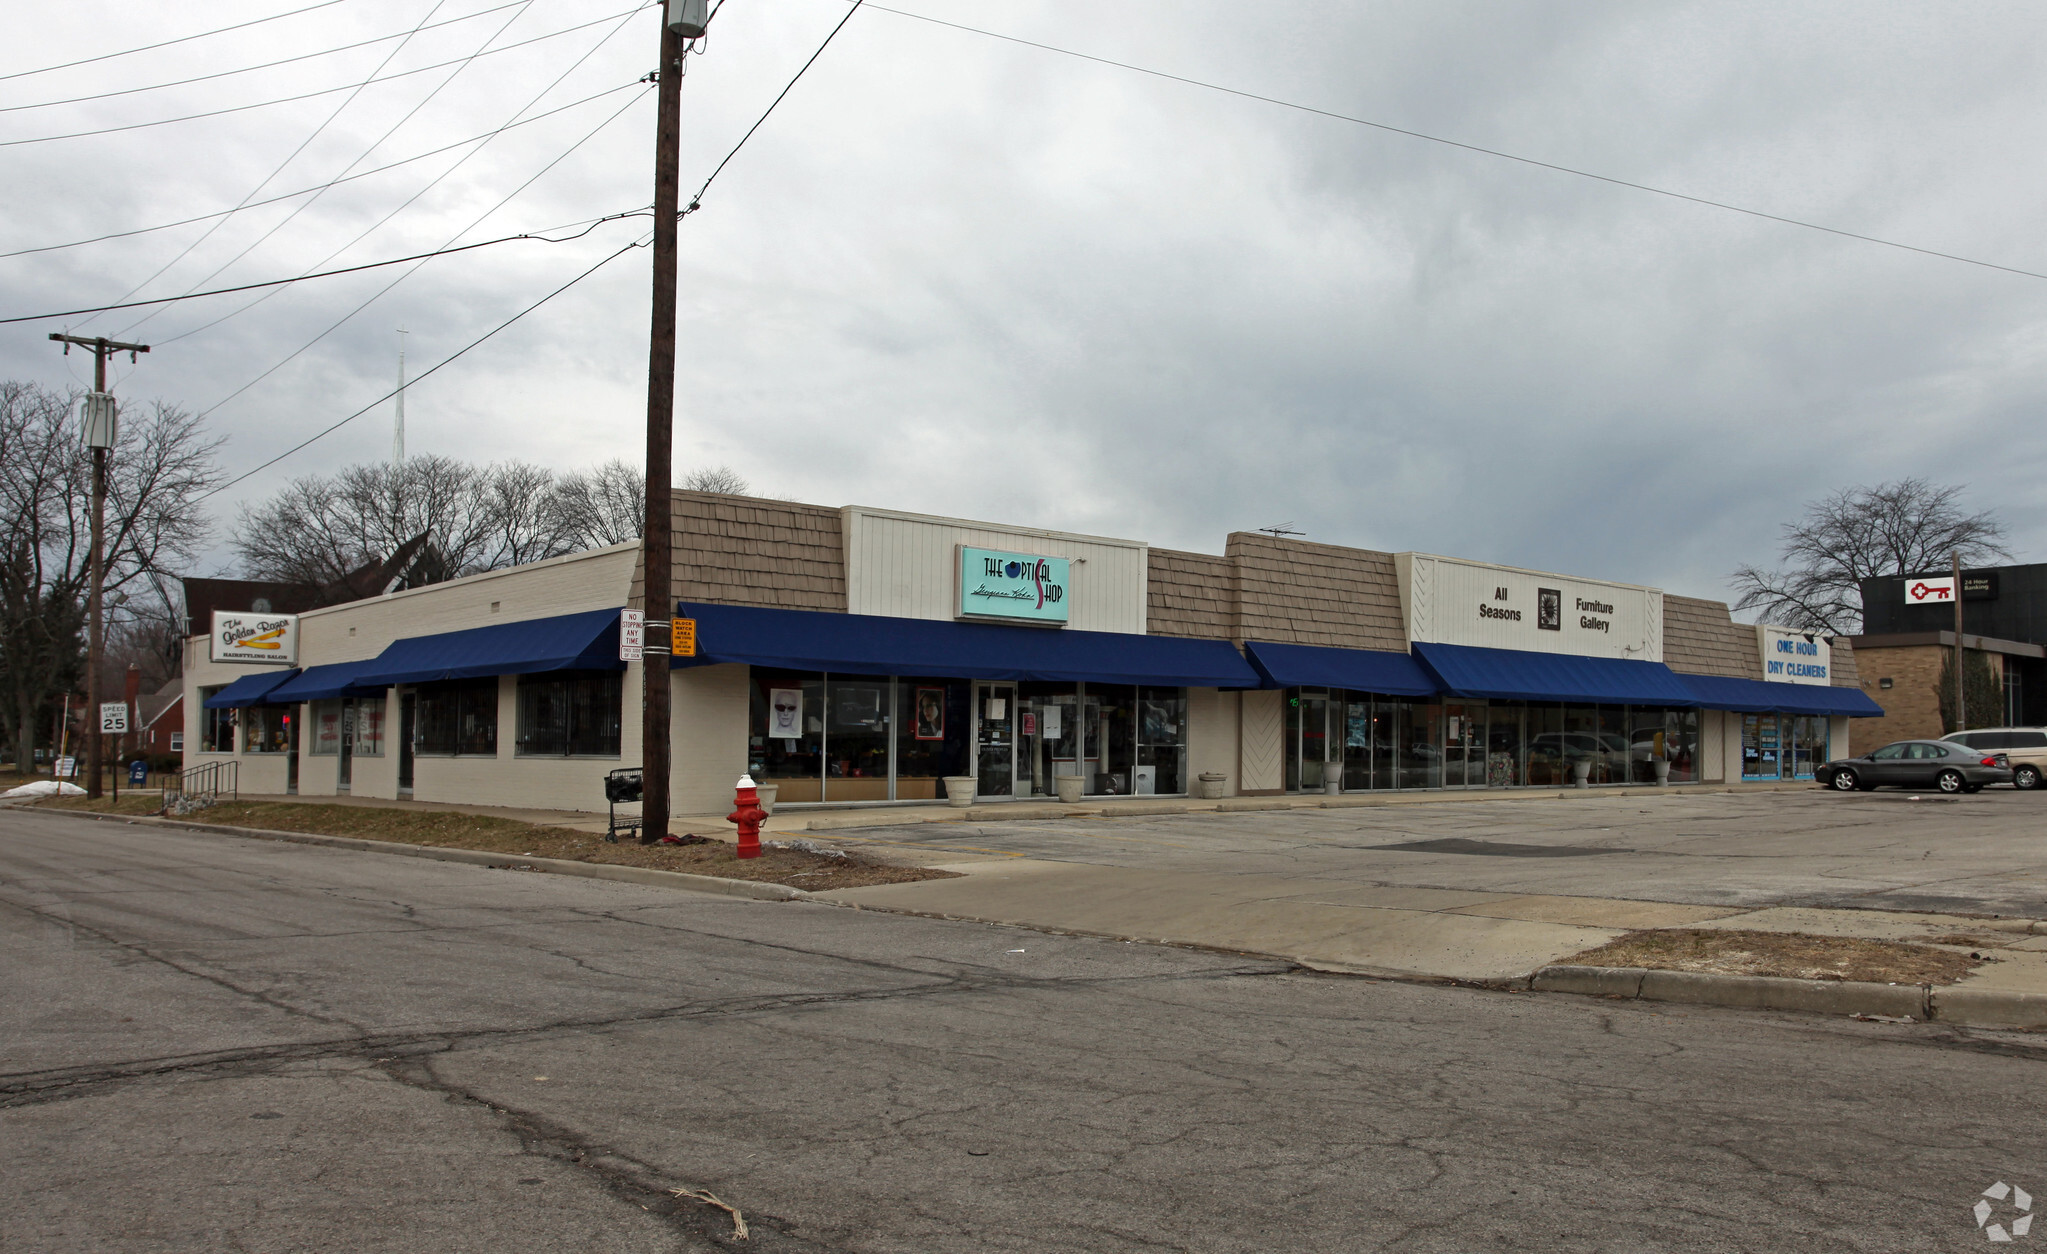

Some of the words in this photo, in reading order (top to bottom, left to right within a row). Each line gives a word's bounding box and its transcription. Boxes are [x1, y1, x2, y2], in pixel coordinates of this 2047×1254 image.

[984, 558, 1003, 577] THE
[1494, 587, 1508, 601] All
[1479, 603, 1522, 621] Seasons
[1576, 598, 1613, 614] Furniture
[222, 627, 256, 645] Golden
[256, 619, 290, 638] Razor
[223, 619, 242, 629] The
[622, 621, 643, 629] STOPPING
[1580, 616, 1610, 633] Gallery
[1777, 640, 1793, 653] ONE
[1796, 642, 1817, 656] HOUR
[1768, 661, 1784, 674] DRY
[1787, 663, 1826, 678] CLEANERS
[104, 719, 125, 729] 25
